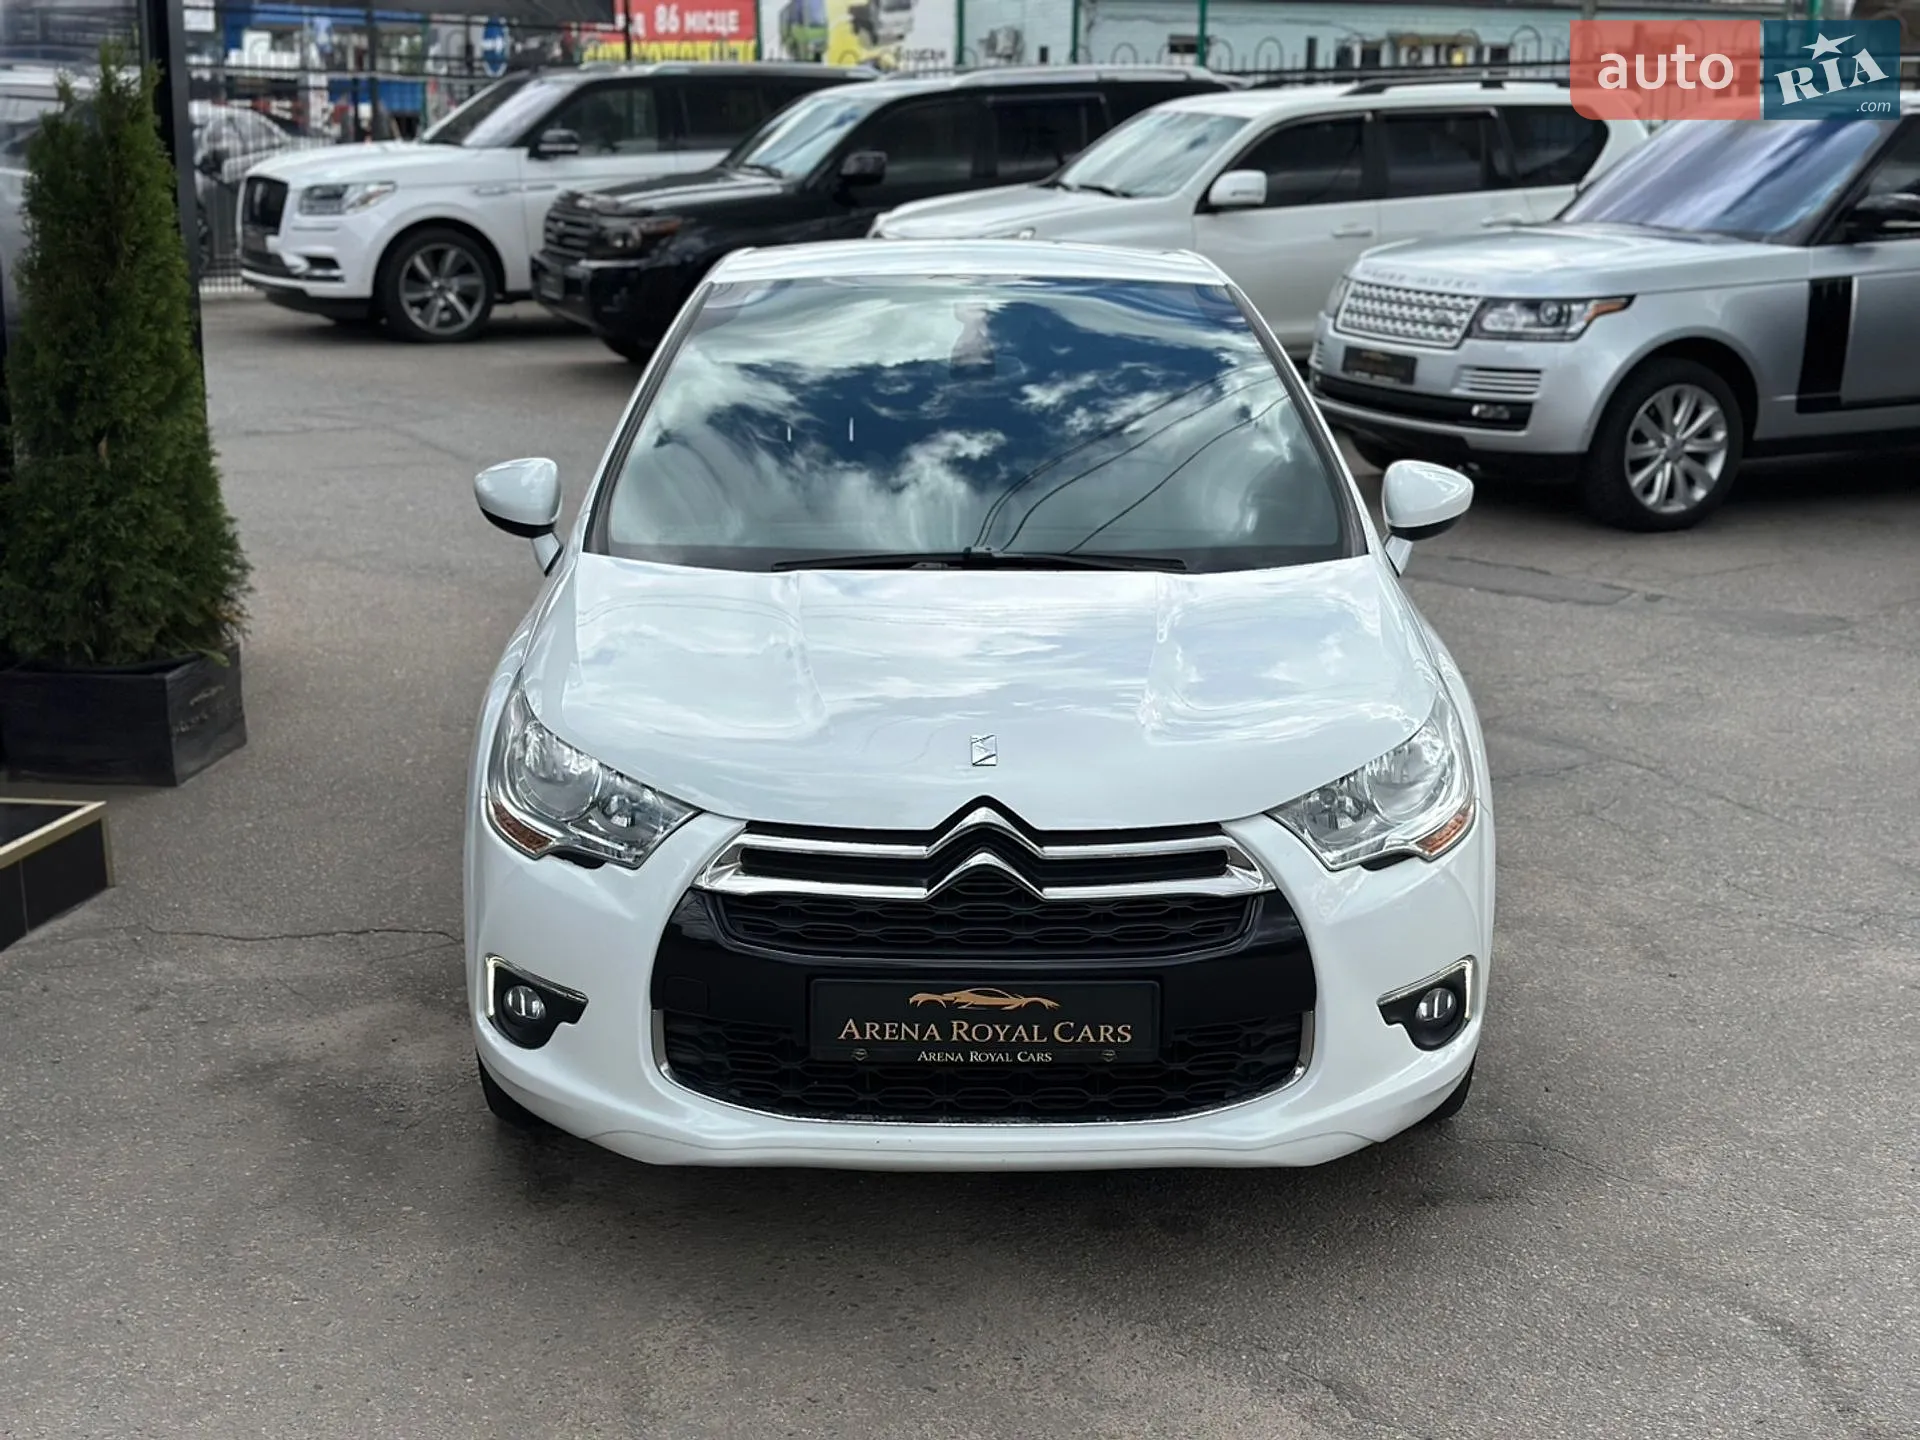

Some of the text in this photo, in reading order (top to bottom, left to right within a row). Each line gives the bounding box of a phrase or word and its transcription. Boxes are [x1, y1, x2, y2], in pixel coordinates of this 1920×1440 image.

[654, 3, 680, 35] 86
[837, 1017, 1133, 1043] ARENA ROYAL CARS
[917, 1050, 1053, 1063] ARENA ROYAL CARS
